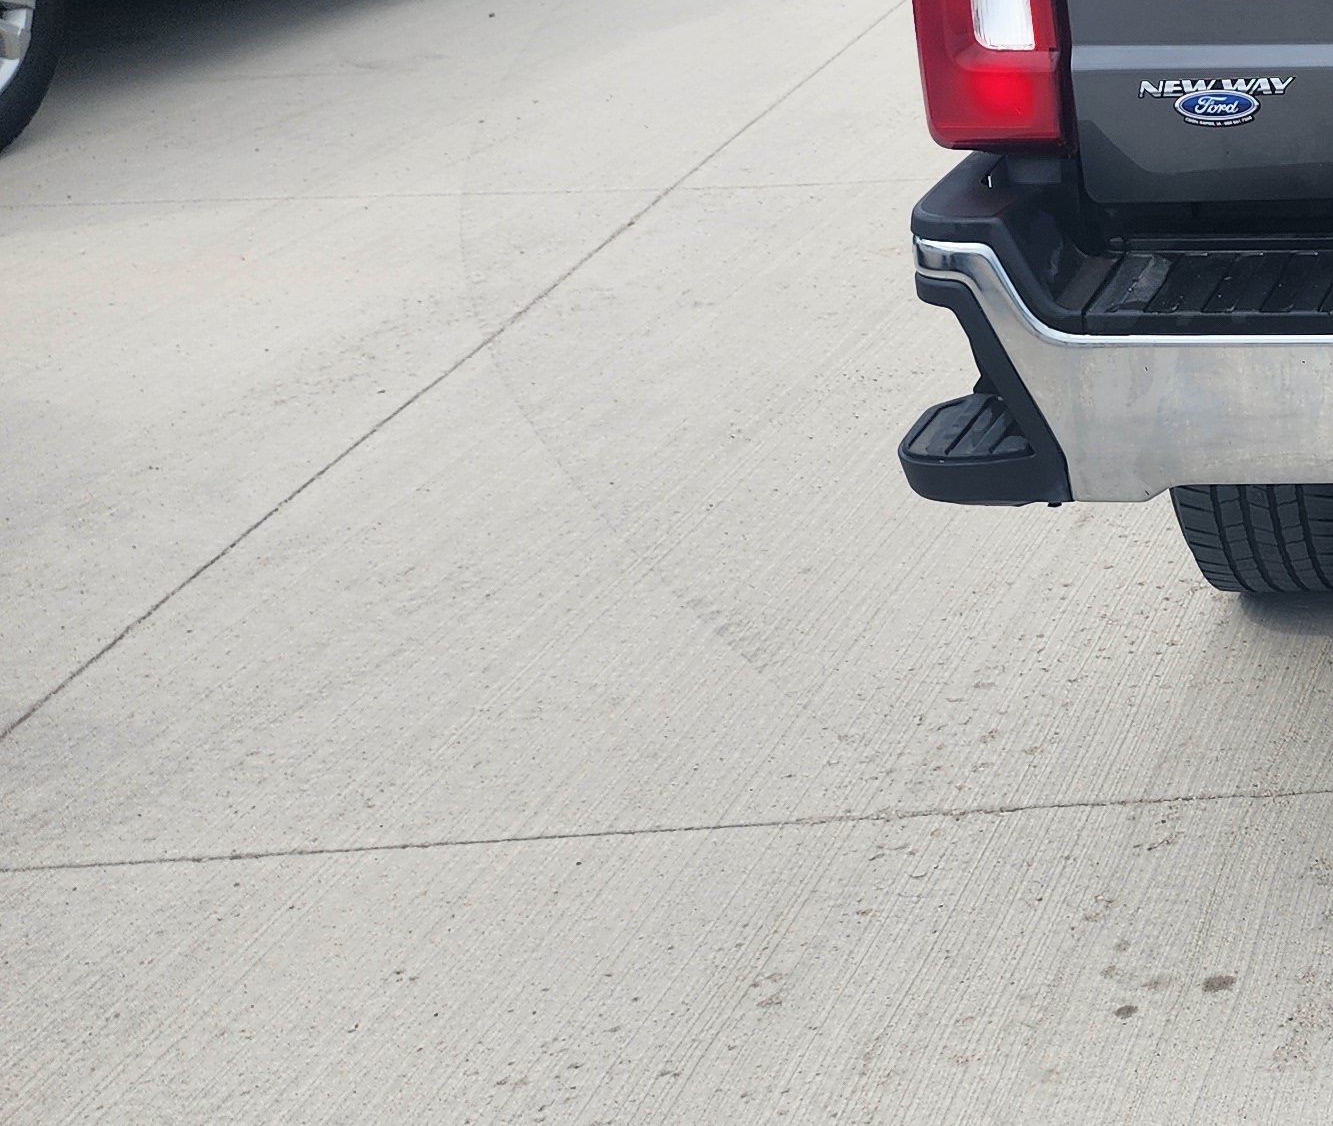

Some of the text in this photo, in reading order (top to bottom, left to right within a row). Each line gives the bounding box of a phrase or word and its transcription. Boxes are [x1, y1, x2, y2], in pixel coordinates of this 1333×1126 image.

[1139, 76, 1296, 98] NEW WAY
[1194, 95, 1239, 114] Ford
